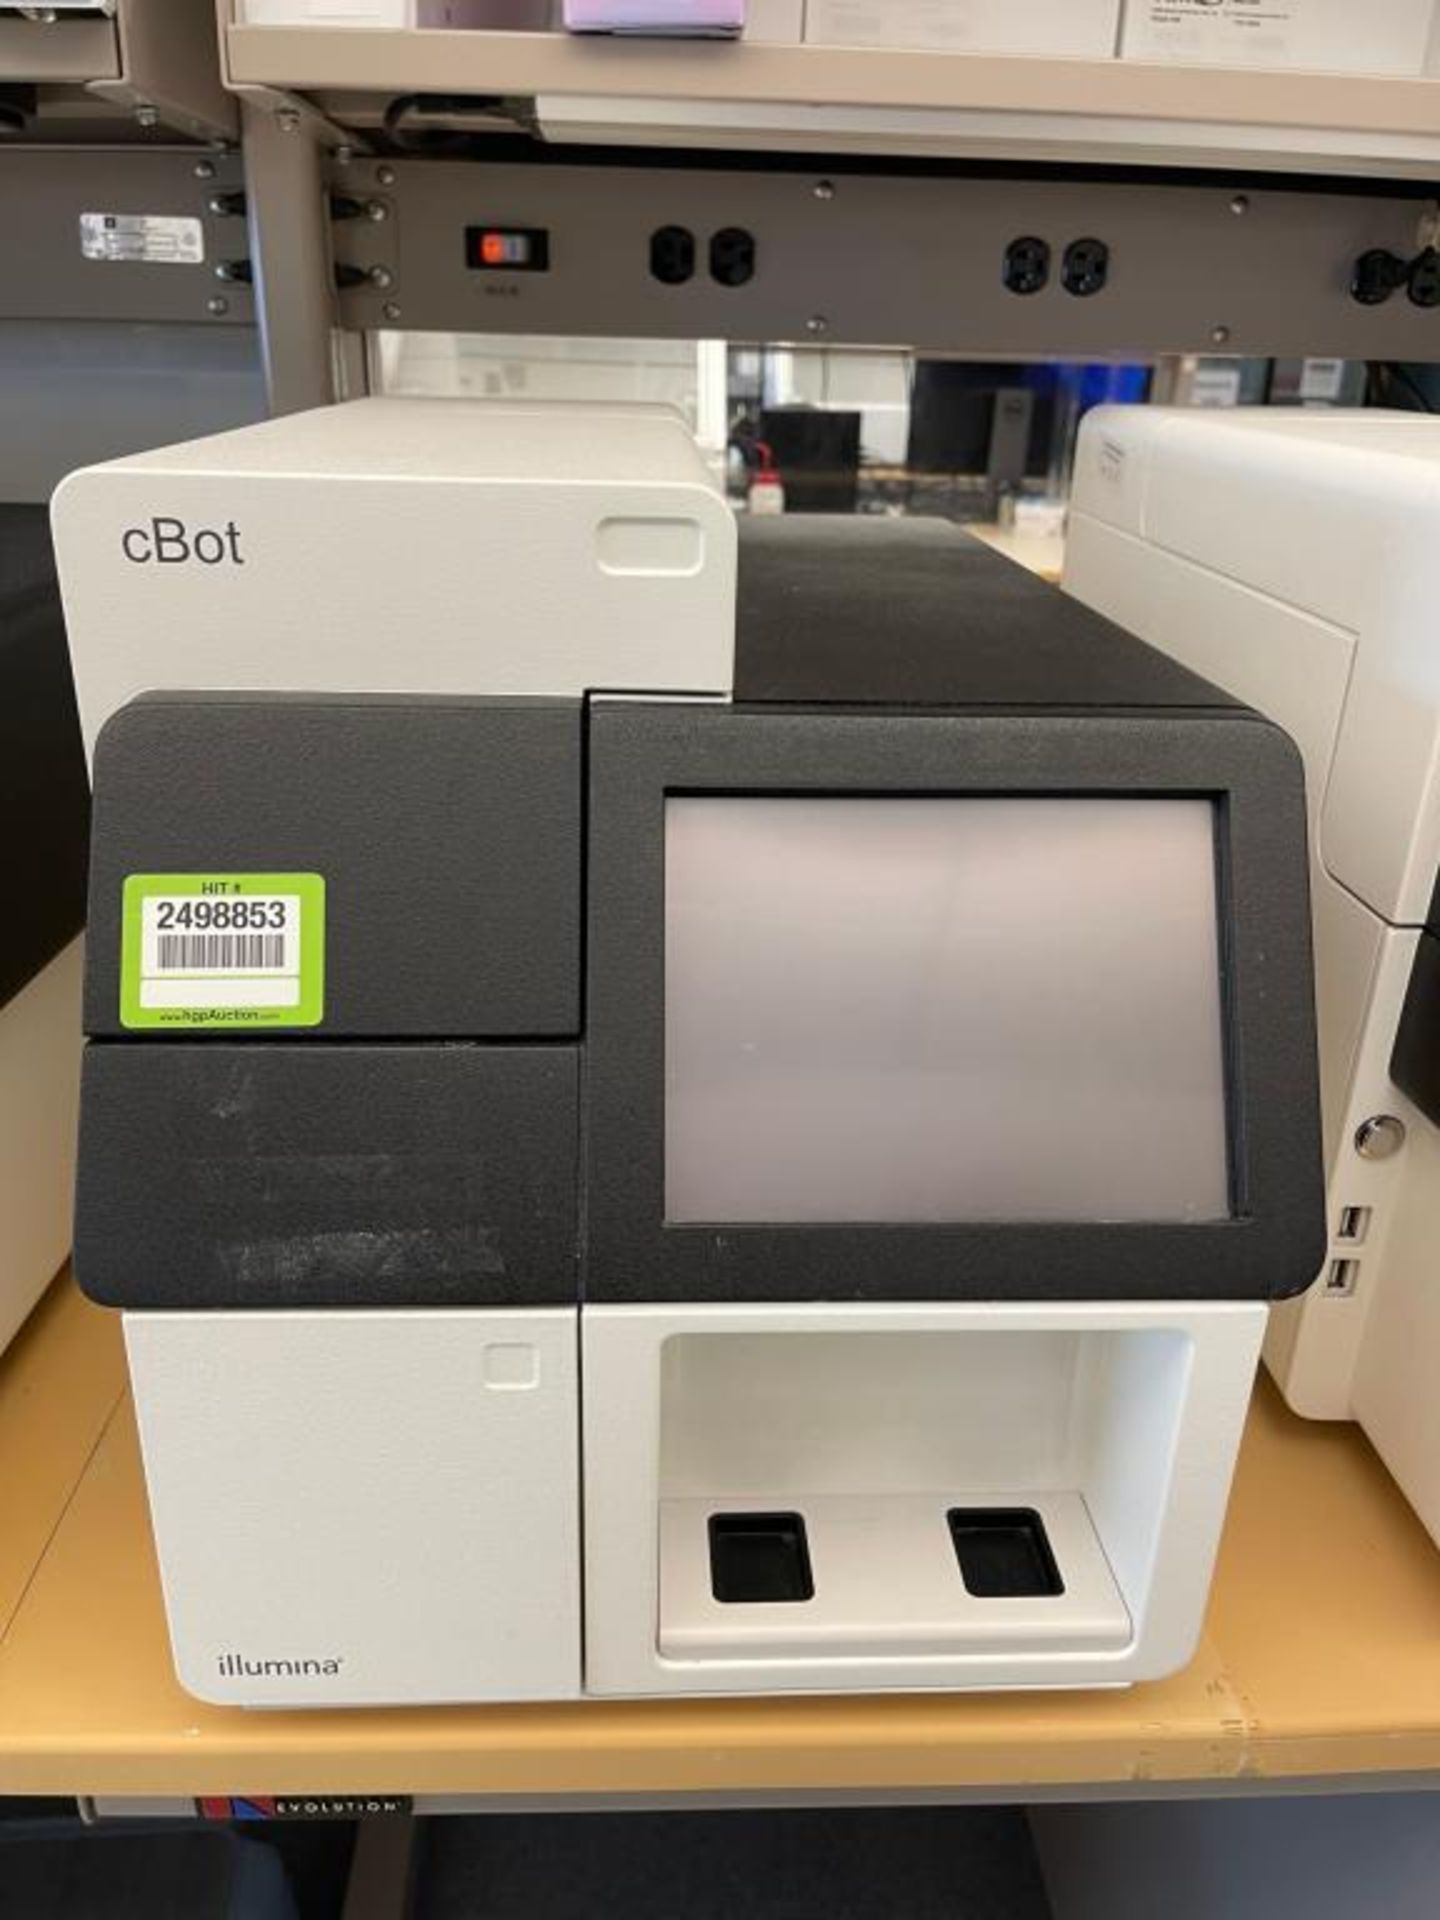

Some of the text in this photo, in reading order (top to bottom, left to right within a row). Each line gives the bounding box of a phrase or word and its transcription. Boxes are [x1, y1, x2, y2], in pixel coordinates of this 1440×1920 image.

[122, 517, 245, 564] cBot
[202, 882, 228, 894] HIT
[156, 901, 286, 929] 2498853
[218, 1653, 341, 1676] illumina
[276, 1801, 397, 1814] EVOLUTION
